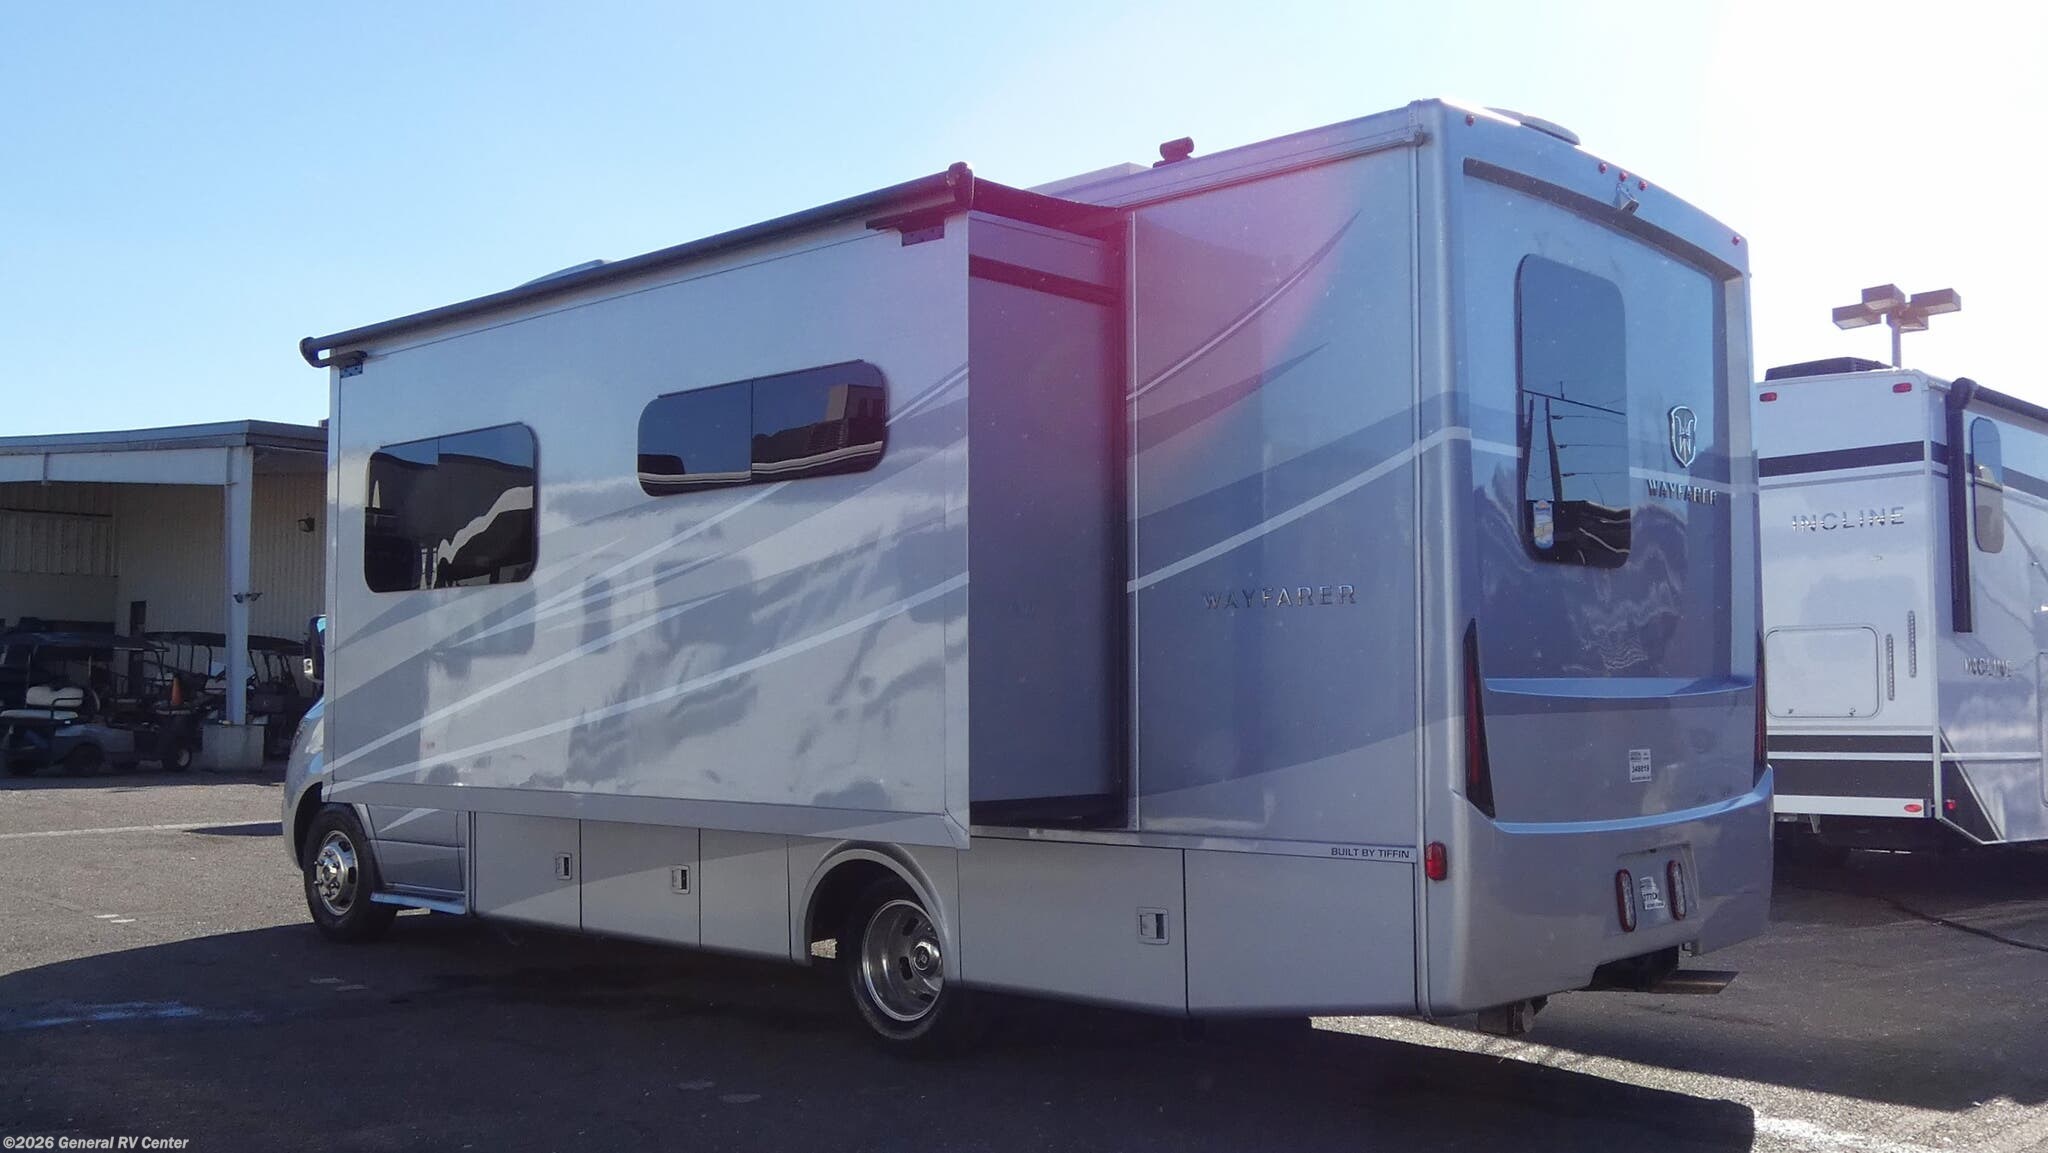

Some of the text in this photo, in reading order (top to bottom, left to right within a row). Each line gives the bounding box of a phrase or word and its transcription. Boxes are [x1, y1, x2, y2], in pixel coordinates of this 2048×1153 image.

[1647, 478, 1718, 505] WAYFARER
[1792, 506, 1904, 532] INCLINE
[1203, 584, 1358, 609] WAYFARER
[1331, 847, 1410, 858] BUILT BY TIFFIN
